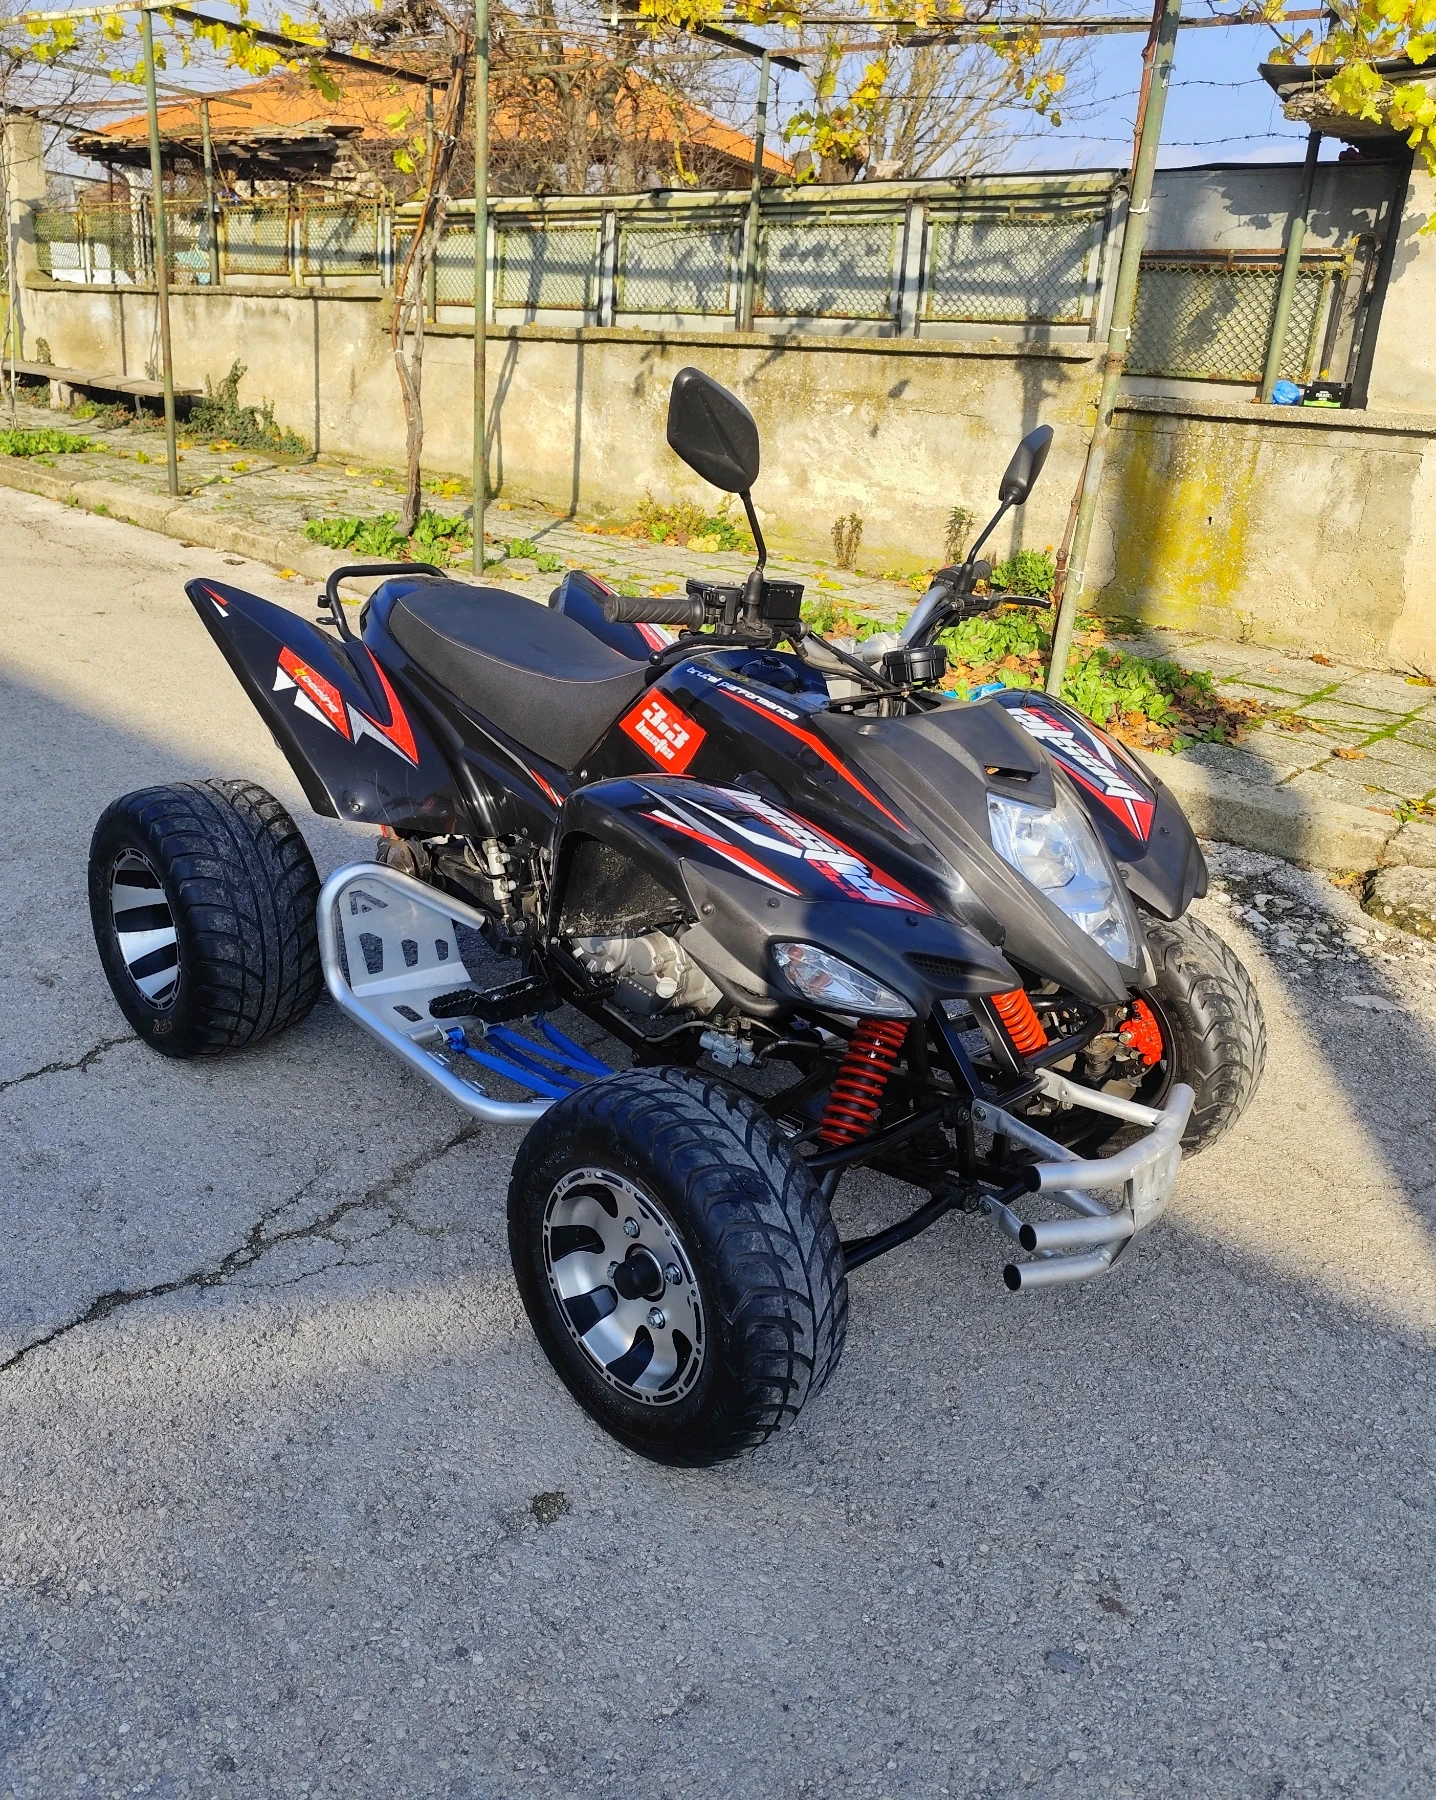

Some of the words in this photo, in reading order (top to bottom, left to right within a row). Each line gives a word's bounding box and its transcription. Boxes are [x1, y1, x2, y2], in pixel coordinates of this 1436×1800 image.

[686, 666, 722, 684] brutal
[717, 681, 800, 721] performance
[641, 701, 691, 750] 3.3
